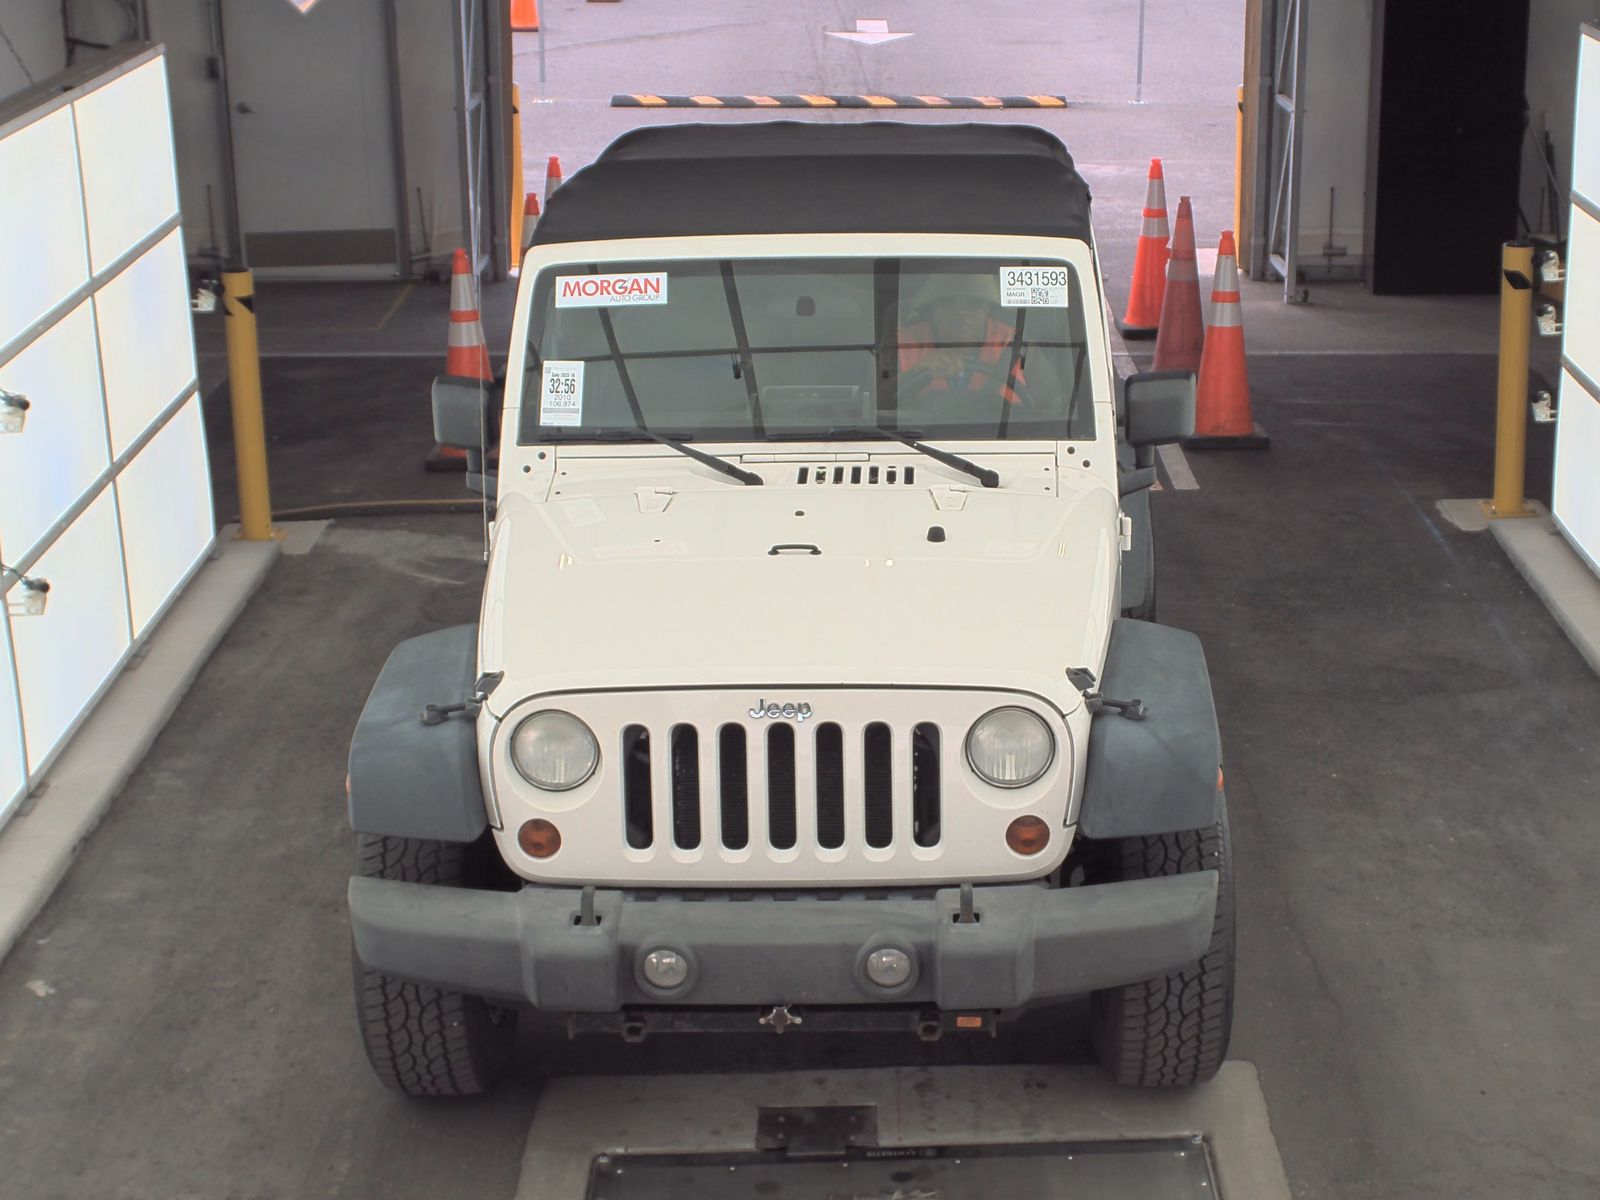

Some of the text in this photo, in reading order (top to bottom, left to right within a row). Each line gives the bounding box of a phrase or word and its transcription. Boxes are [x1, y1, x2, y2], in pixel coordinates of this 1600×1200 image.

[1007, 271, 1067, 286] 3431593
[562, 278, 660, 297] MORGAN
[609, 293, 660, 303] AUTO GROUP
[549, 378, 576, 394] 32:56
[749, 698, 812, 723] Jeep
